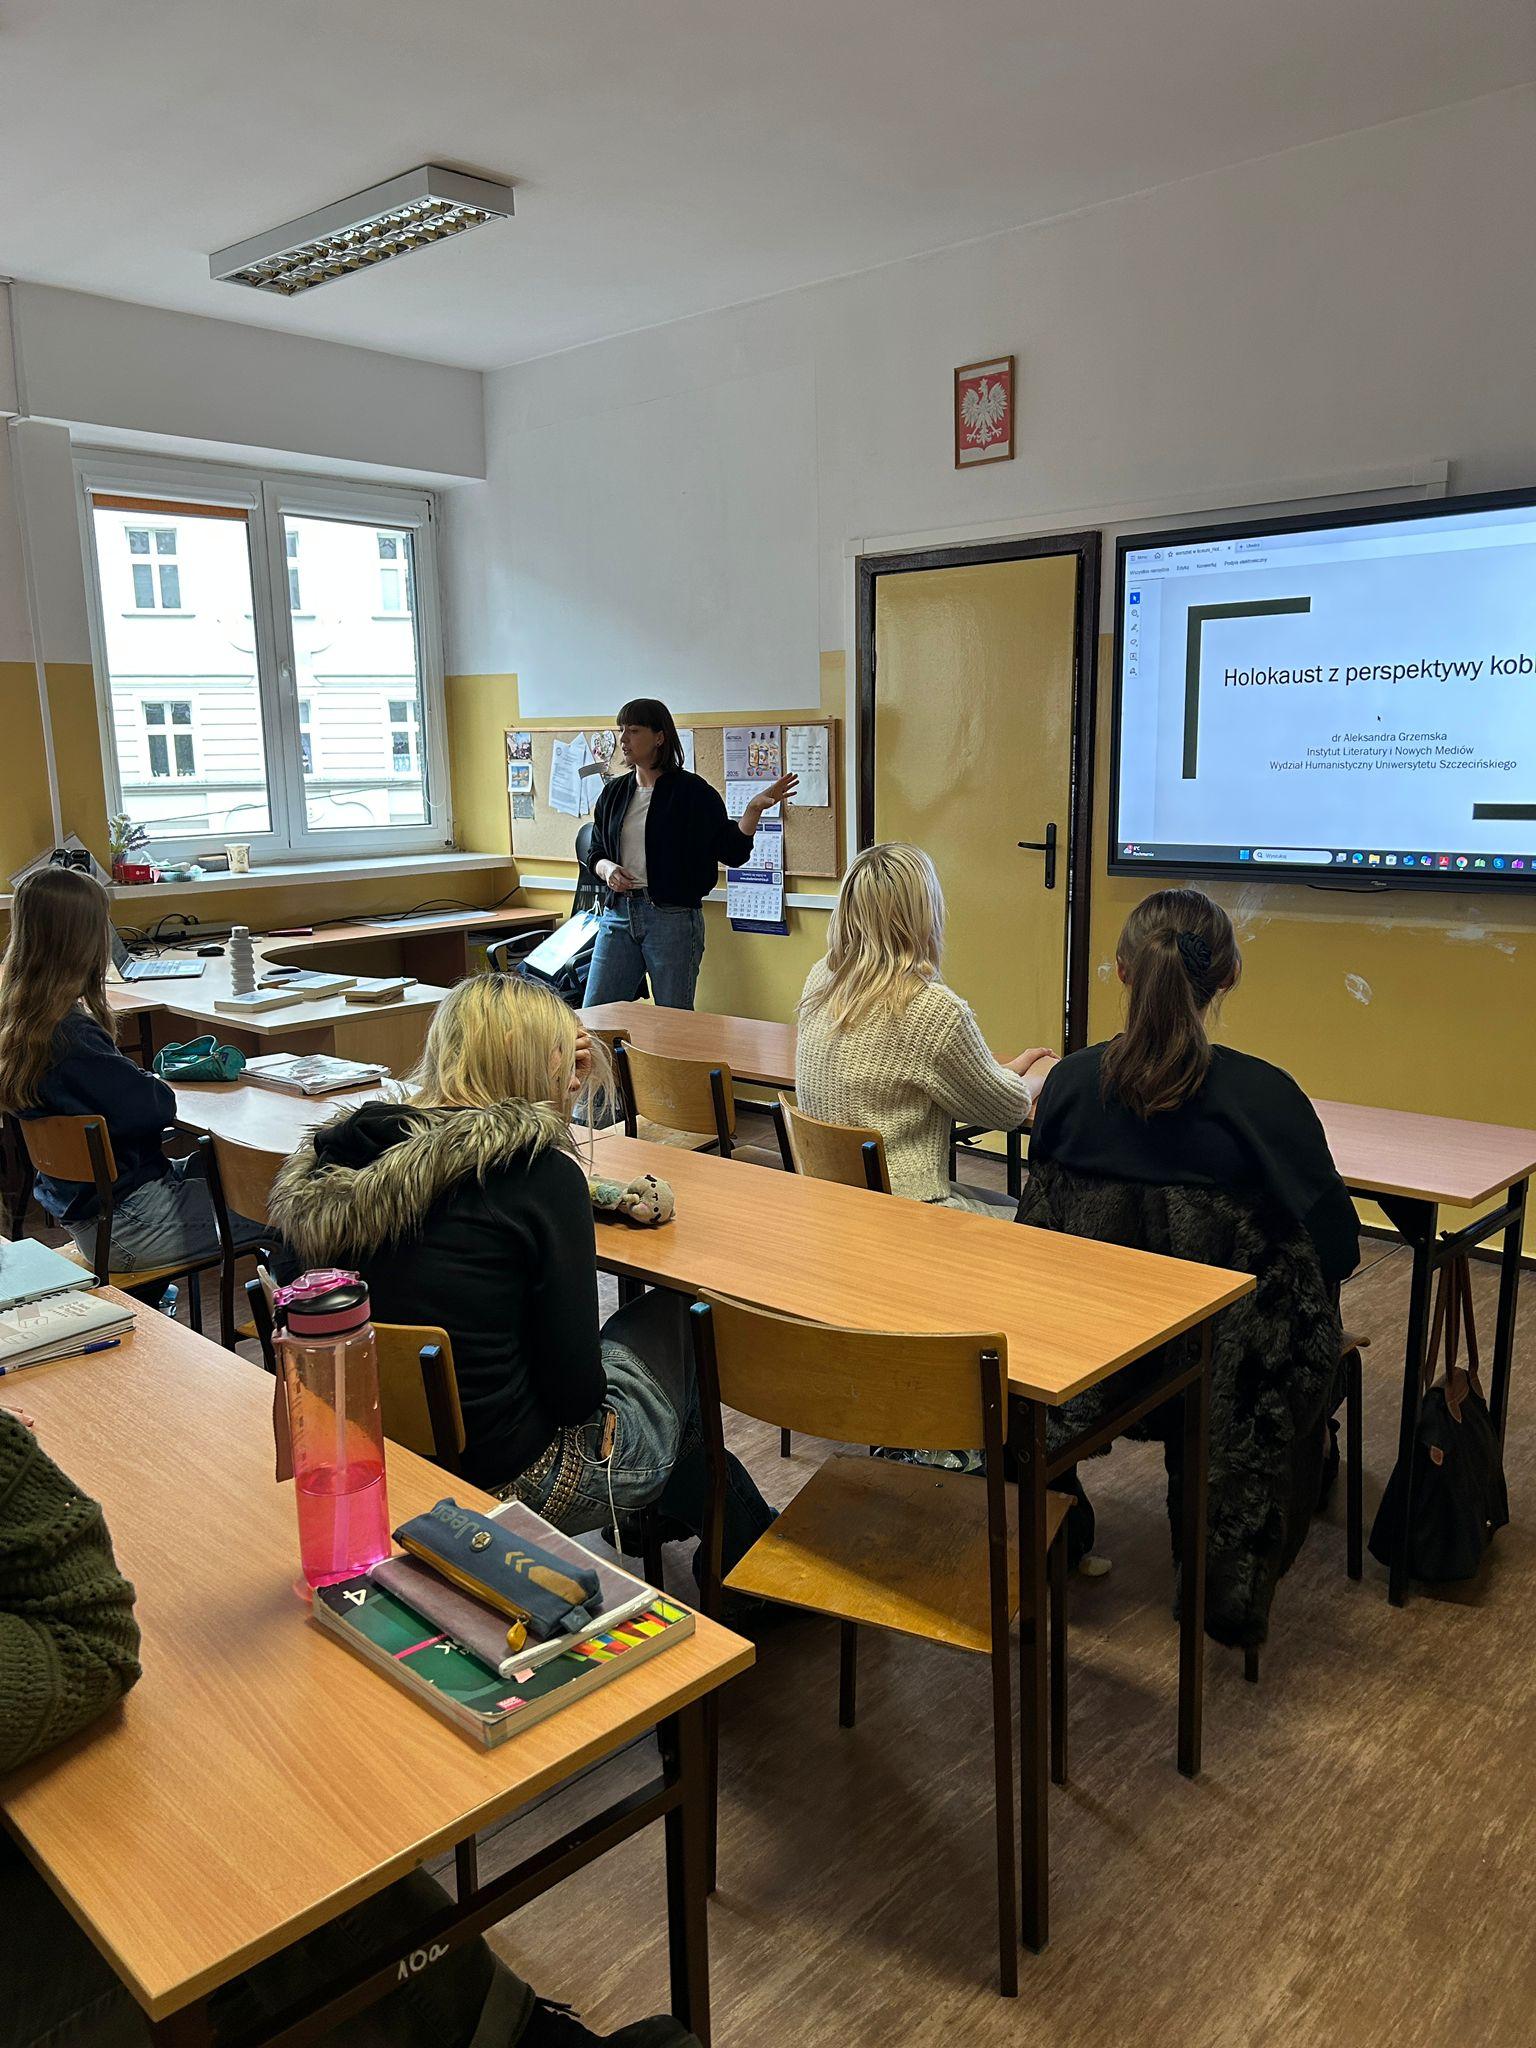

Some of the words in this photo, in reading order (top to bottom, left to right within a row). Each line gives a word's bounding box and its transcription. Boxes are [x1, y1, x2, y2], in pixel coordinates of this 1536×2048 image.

[1224, 665, 1323, 686] Holokaust
[1328, 667, 1339, 682] z
[1346, 659, 1484, 686] perspektywy
[1490, 653, 1536, 676] kob
[1331, 733, 1341, 743] dr
[1343, 732, 1396, 743] Aleksandra
[1398, 731, 1448, 742] Grzemska
[1307, 747, 1341, 758] Instytut
[1343, 746, 1387, 758] Literatury
[1395, 746, 1433, 757] Nowych
[1435, 745, 1475, 756] Mediów
[1269, 760, 1303, 772] Wydział
[1305, 760, 1373, 772] Humanistyczny
[1375, 759, 1437, 771] Uniwersytetu
[1439, 758, 1517, 771] Szczecińskiego
[342, 1588, 367, 1607] 4
[397, 1943, 450, 1981] 10a
